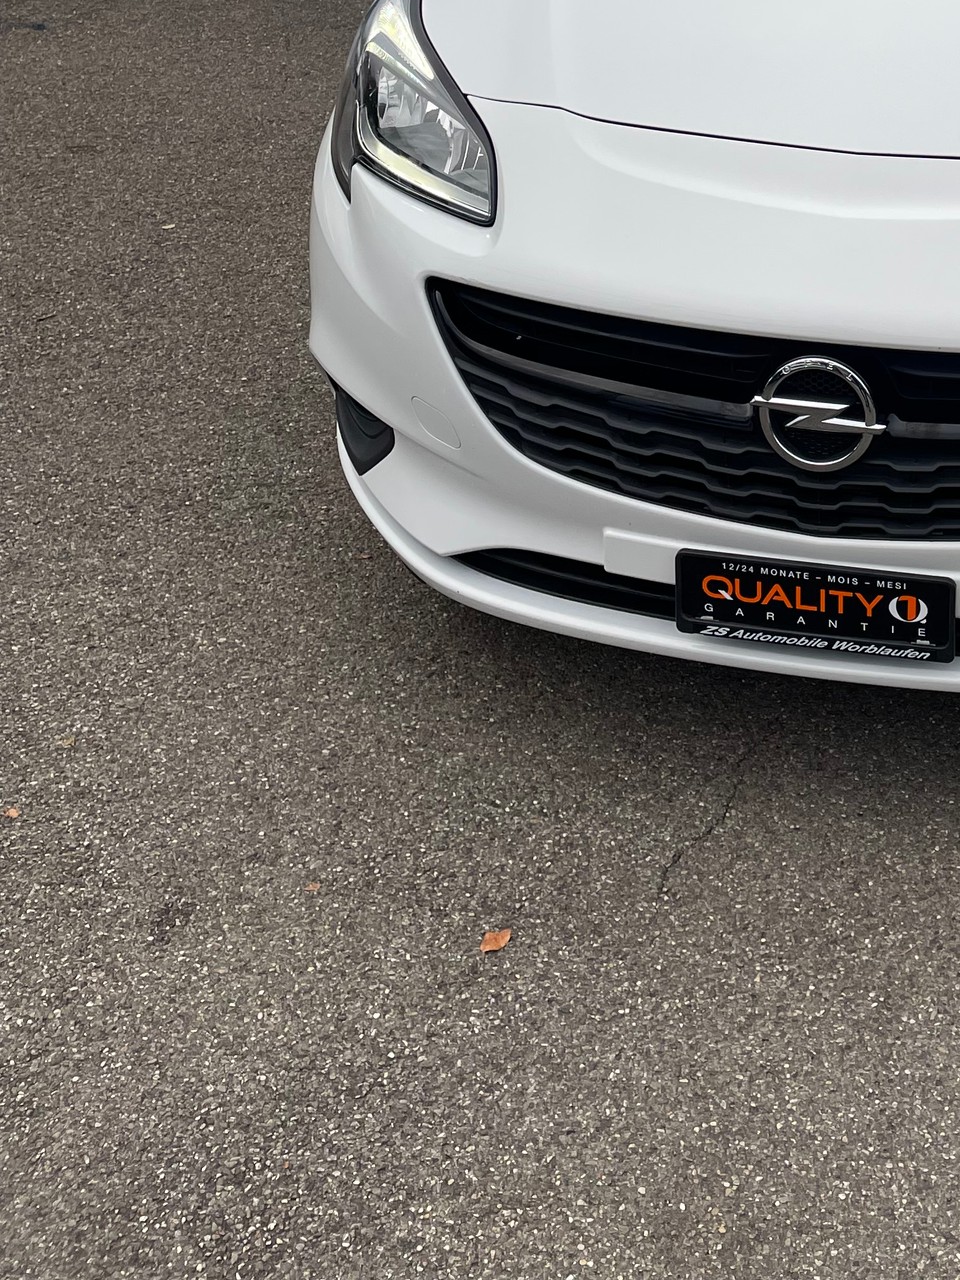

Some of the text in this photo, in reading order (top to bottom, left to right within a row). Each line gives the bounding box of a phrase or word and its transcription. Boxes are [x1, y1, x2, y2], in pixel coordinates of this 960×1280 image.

[722, 563, 754, 573] 12/24
[760, 568, 809, 580] MONATE
[828, 575, 858, 586] MOIS
[876, 580, 907, 590] MESI
[702, 575, 884, 618] QUALITY
[704, 603, 926, 637] GARANTIE
[700, 625, 931, 660] ZS Automobile Worblaufen
